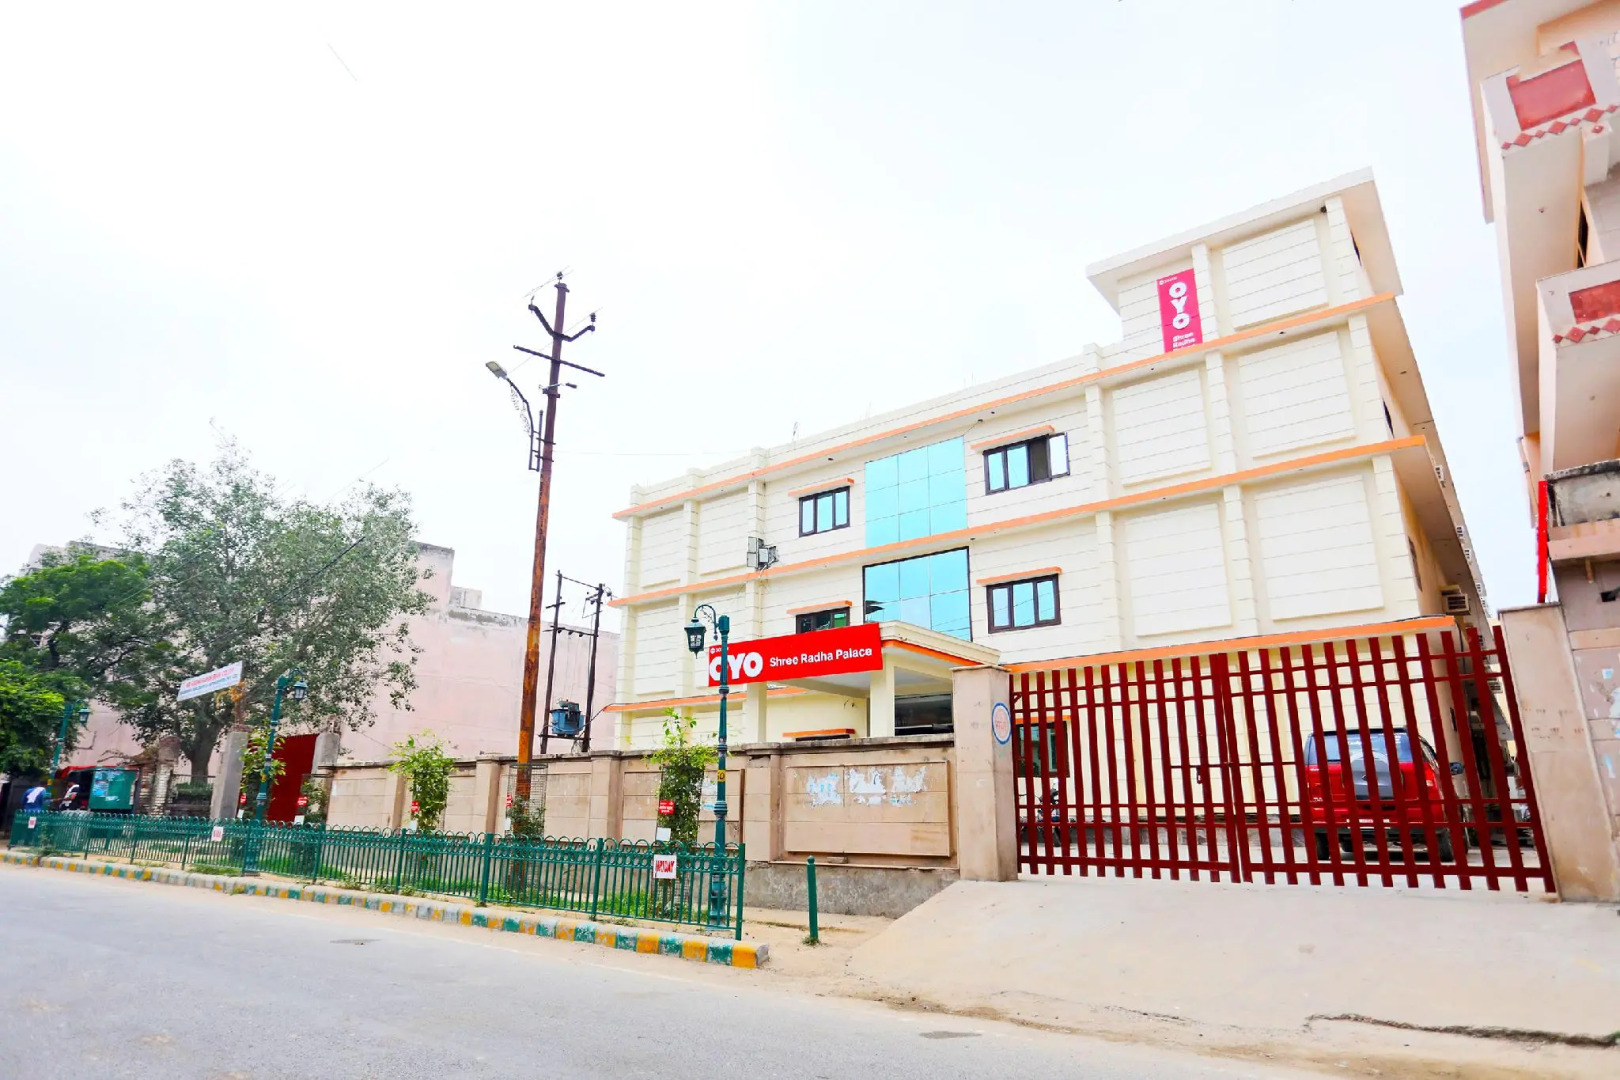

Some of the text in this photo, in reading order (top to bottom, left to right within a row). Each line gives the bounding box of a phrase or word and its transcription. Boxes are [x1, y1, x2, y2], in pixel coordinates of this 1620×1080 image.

[1168, 281, 1190, 330] OYO
[709, 647, 873, 682] OYO Shree Radha Palace
